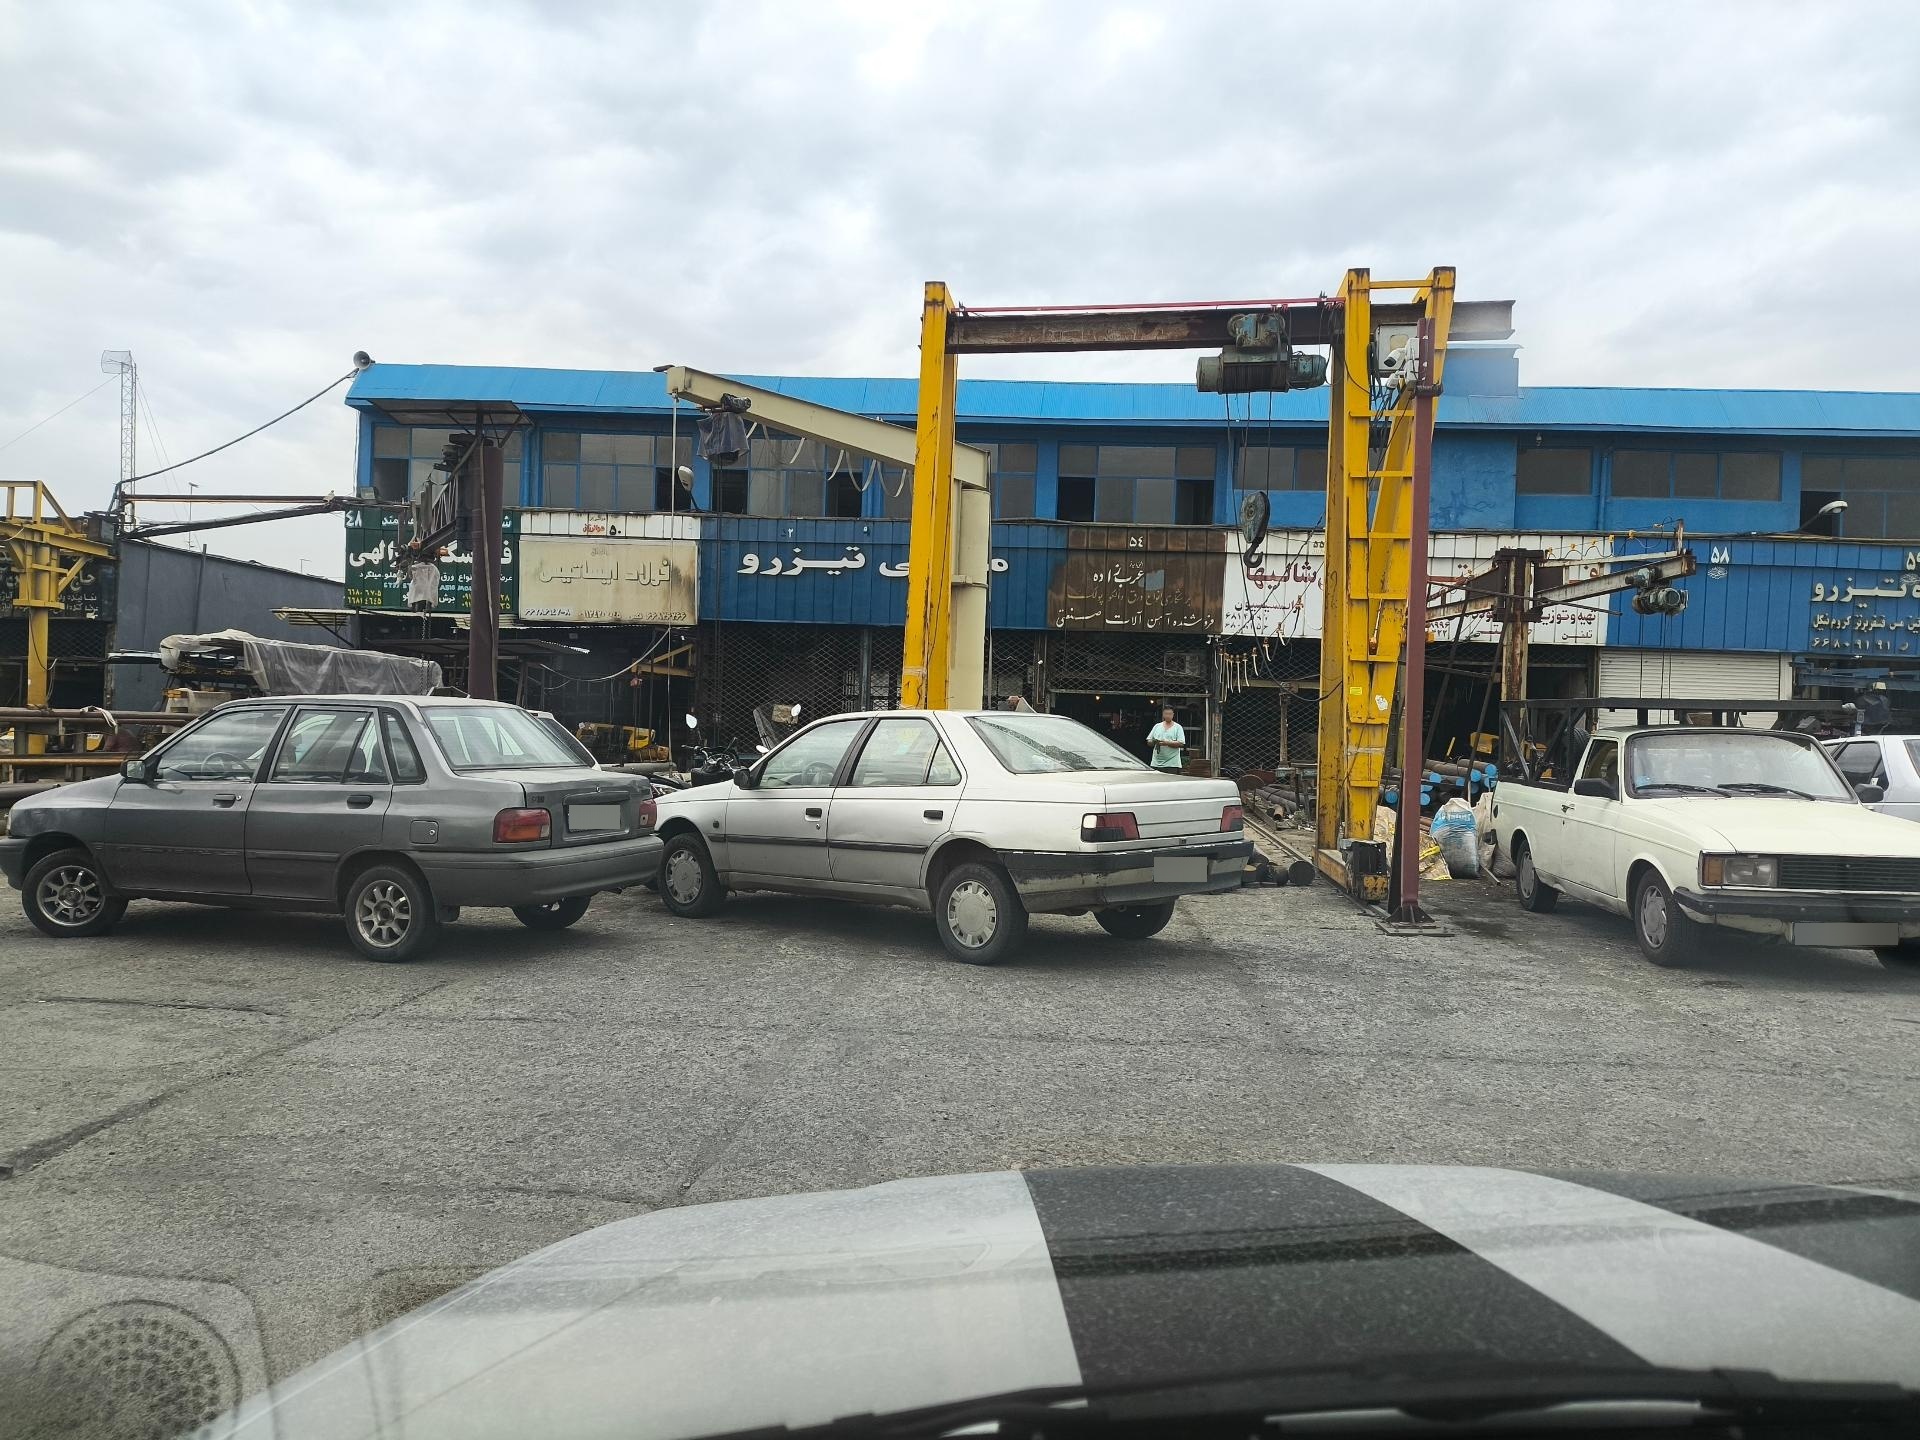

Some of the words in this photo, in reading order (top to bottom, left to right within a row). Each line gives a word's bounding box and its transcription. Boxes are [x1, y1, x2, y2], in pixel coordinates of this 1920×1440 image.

[736, 546, 866, 576] تیزرو
[1711, 546, 1729, 564] ۵۸
[441, 572, 454, 582] ورق
[1128, 590, 1143, 604] ورق
[1811, 577, 1907, 608] تیزرو
[1056, 607, 1102, 628] صنعتی
[1105, 610, 1142, 626] آلات
[1147, 612, 1172, 629] آهن
[1173, 614, 1215, 630] فروشنده
[1540, 610, 1570, 625] توزی
